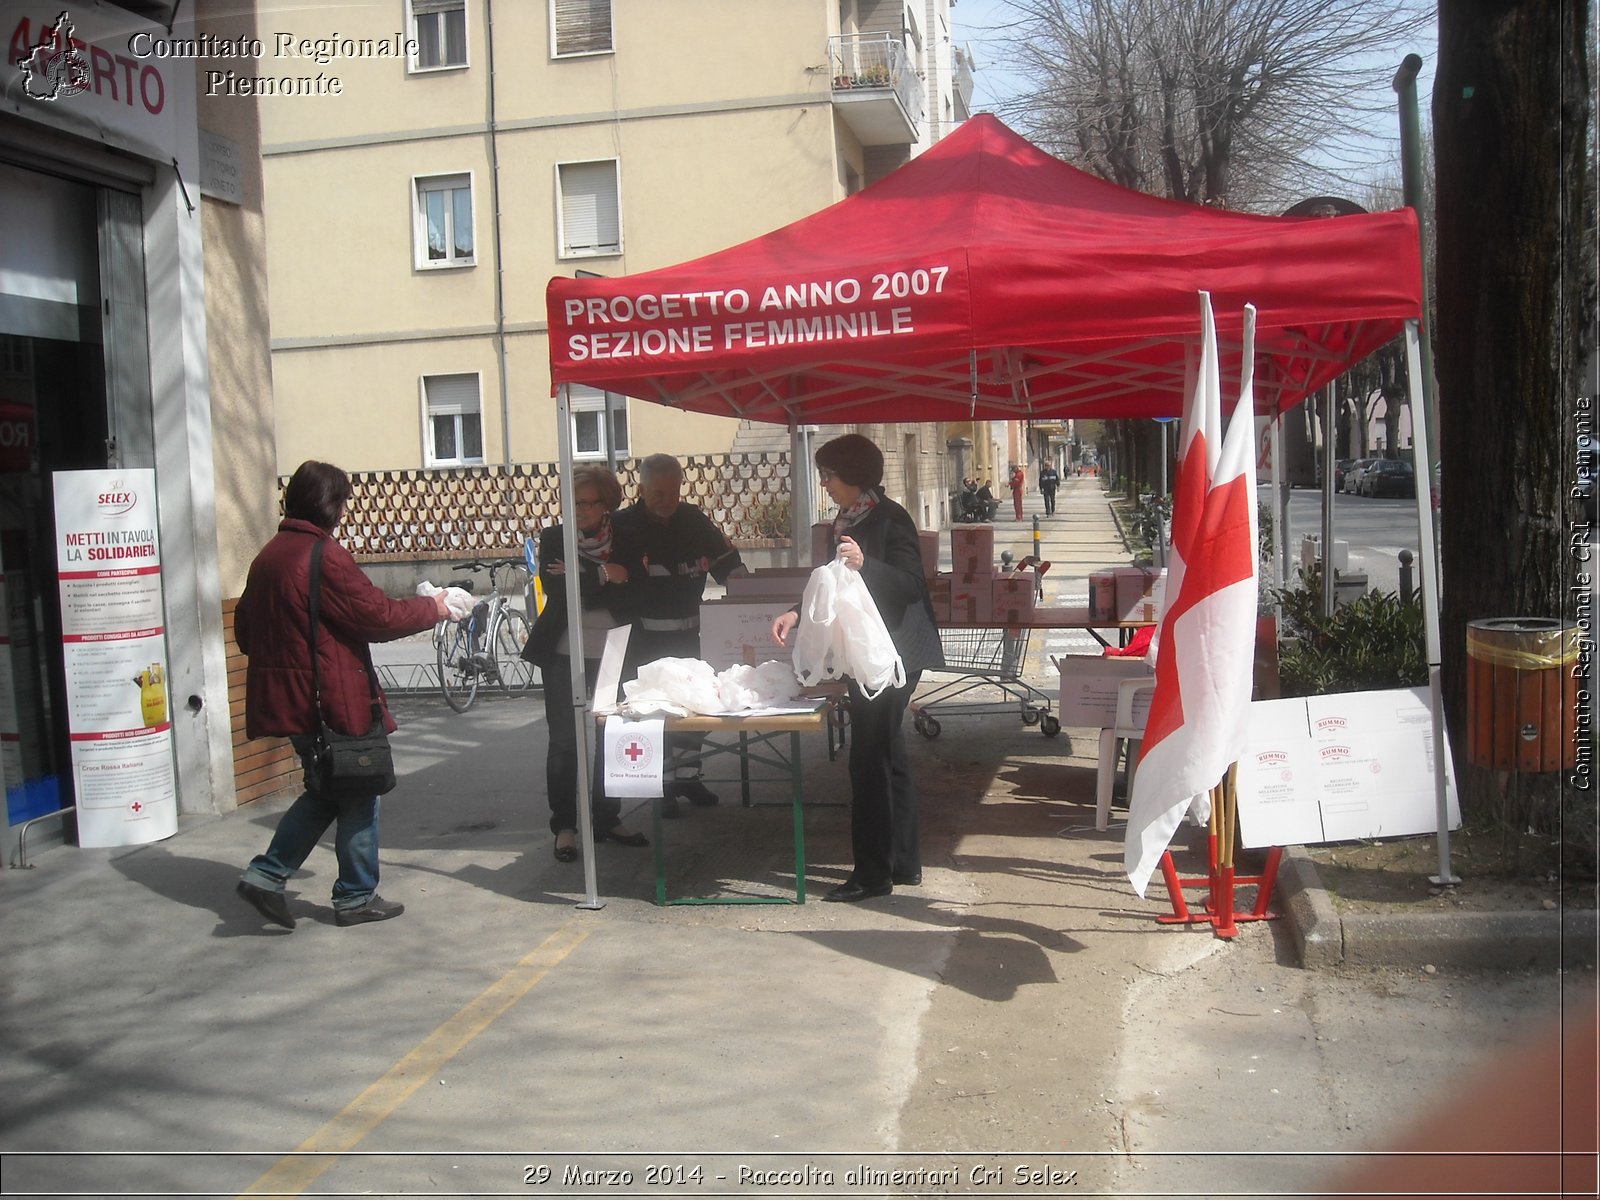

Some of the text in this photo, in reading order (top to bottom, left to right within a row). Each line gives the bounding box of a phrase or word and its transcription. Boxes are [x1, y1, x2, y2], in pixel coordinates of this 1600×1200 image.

[8, 16, 165, 115] APERTO
[564, 266, 950, 326] PROGETTO ANNO 2007
[568, 306, 914, 361] SEZIONE FEMMINILE
[98, 492, 131, 504] SELEX
[66, 529, 155, 547] METTI IN TAVOLA
[67, 542, 156, 562] LA SOLIDARIETÀ
[1318, 718, 1345, 728] RUMMO
[1258, 752, 1286, 762] RUMMO
[1321, 747, 1349, 757] RUMMO
